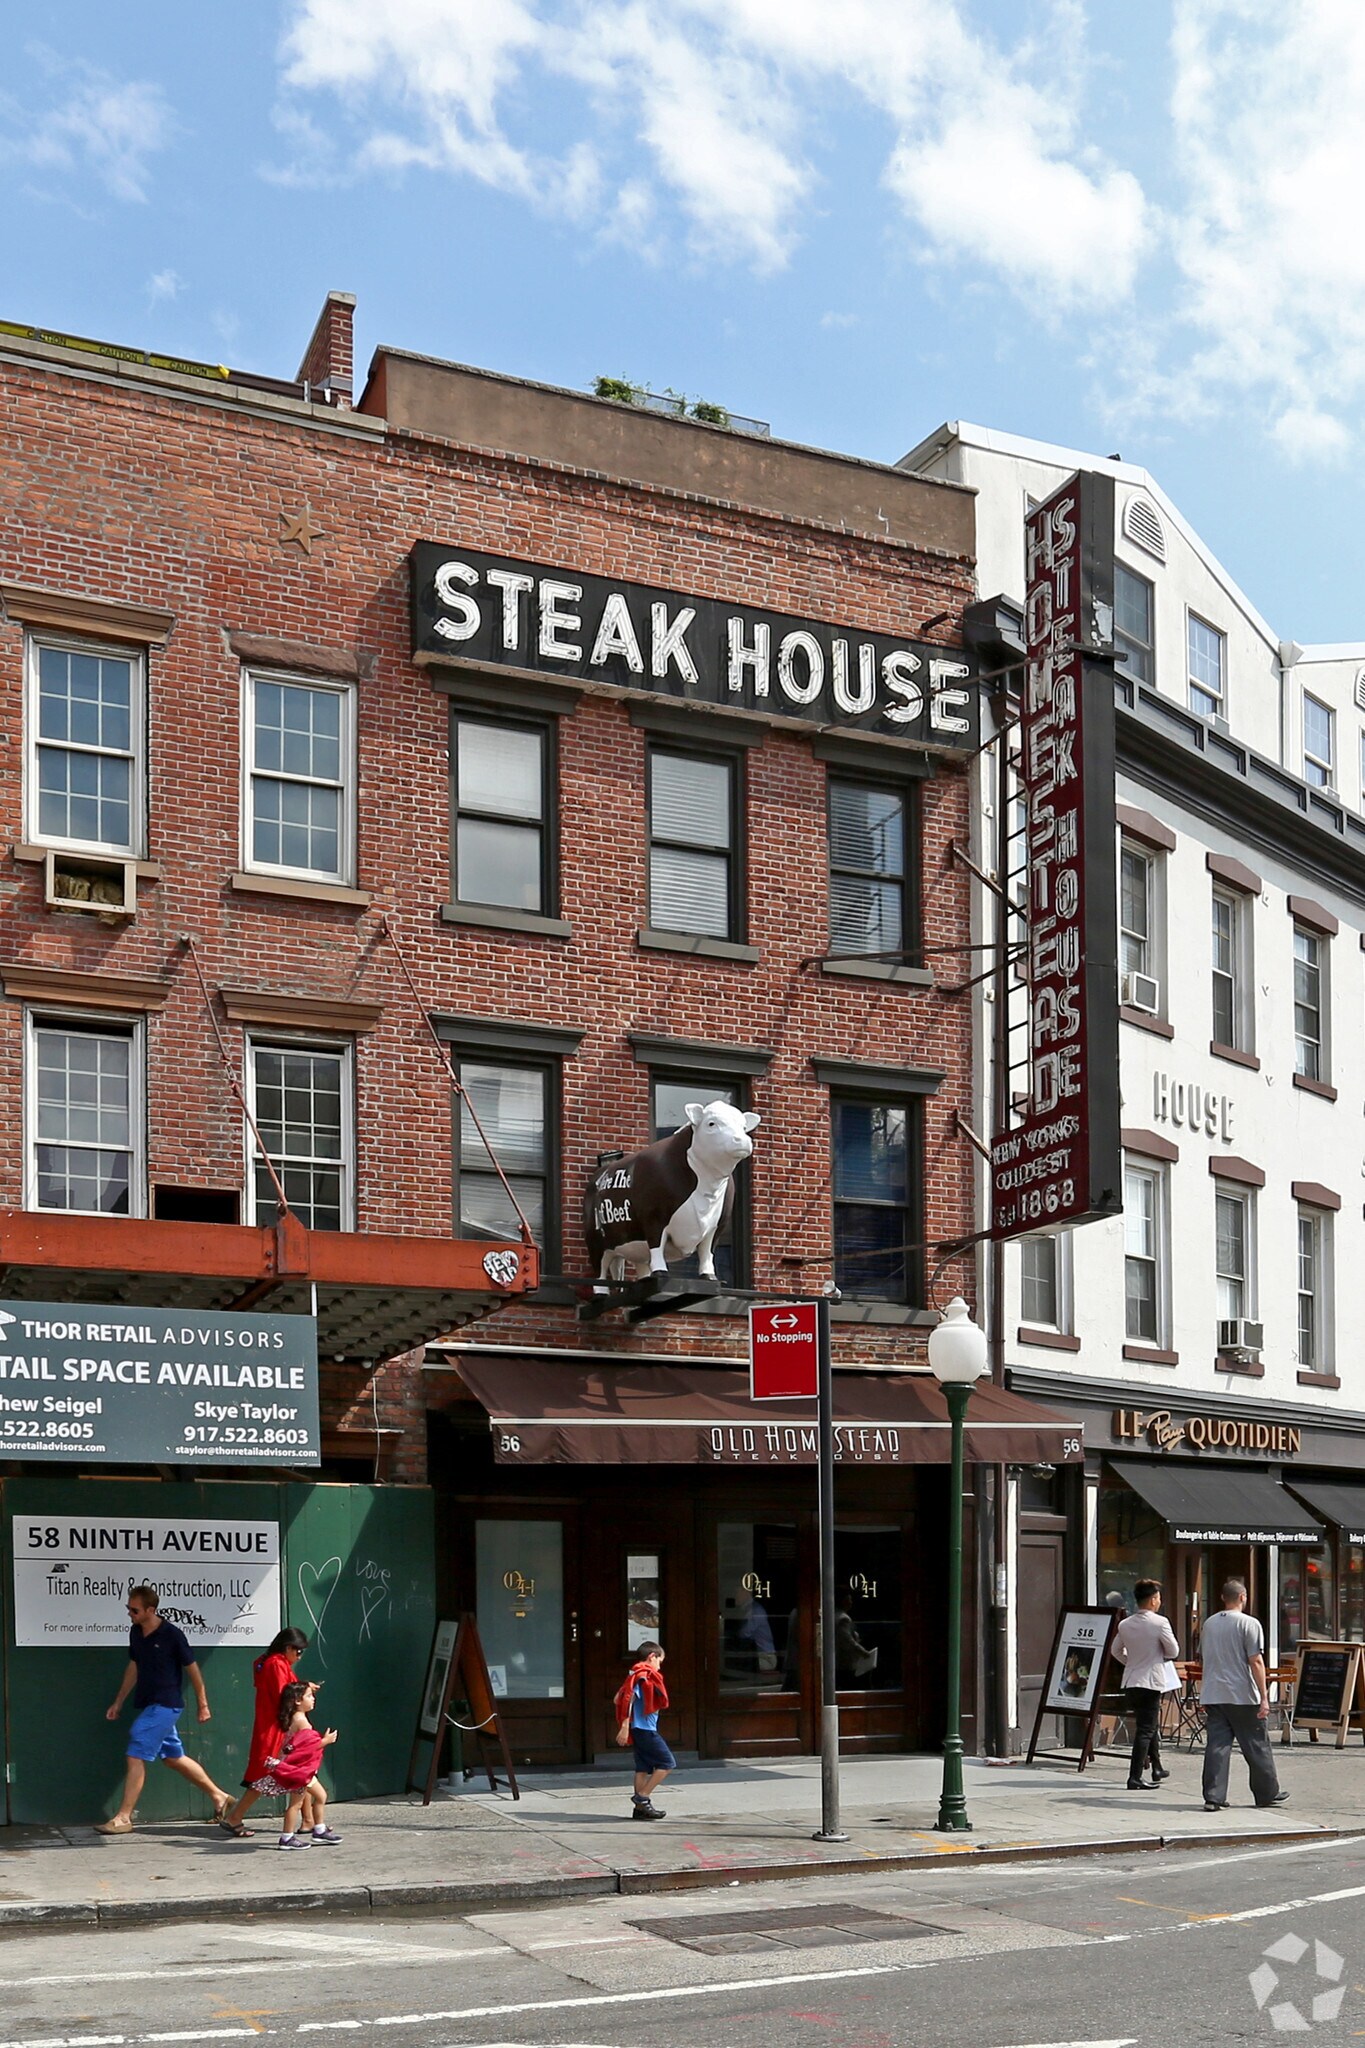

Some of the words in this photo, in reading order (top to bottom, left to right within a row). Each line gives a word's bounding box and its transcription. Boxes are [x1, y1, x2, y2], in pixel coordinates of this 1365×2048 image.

[26, 329, 67, 346] CUTION
[99, 346, 138, 361] CAUTION
[169, 360, 207, 375] CAUTION
[432, 559, 700, 684] STEAK
[726, 615, 971, 735] HOUSE
[1051, 497, 1079, 787] STEAK
[1024, 509, 1059, 1117] HOMESTEAD
[1053, 807, 1082, 1098] HOUSE
[1153, 1070, 1235, 1143] HOUSE
[612, 1169, 631, 1189] The
[604, 1198, 632, 1223] Beef
[1020, 1179, 1075, 1221] 1868
[21, 1320, 82, 1341] THOR
[86, 1324, 157, 1344] RETAIL
[162, 1328, 284, 1349] ADVISORS
[756, 1333, 770, 1343] No
[771, 1331, 813, 1344] Stopping
[0, 1355, 57, 1381] TAIL
[63, 1358, 151, 1384] SPACE
[157, 1362, 305, 1390] AVAILABLE
[43, 1396, 102, 1418] Seigel
[194, 1401, 239, 1422] Skye
[240, 1402, 298, 1424] Taylor
[184, 1425, 309, 1445] 917.522.8603
[711, 1428, 755, 1452] OLD
[765, 1425, 900, 1453] HOMSTEAD
[1116, 1409, 1144, 1438] LE
[1146, 1410, 1186, 1451] Pain
[1188, 1417, 1301, 1453] QUOTIDIEN
[175, 1445, 318, 1458] staylor@thorretailadvisors.com
[500, 1435, 521, 1452] 56
[1063, 1438, 1080, 1453] 56
[816, 1453, 900, 1461] OUSE
[28, 1526, 60, 1549] 58
[69, 1528, 153, 1551] NINTH
[162, 1530, 268, 1553] AVENUE
[46, 1576, 79, 1596] Titan
[84, 1576, 124, 1600] Realty
[230, 1579, 251, 1598] LLC
[43, 1623, 58, 1633] For
[60, 1624, 83, 1633] more
[85, 1623, 130, 1633] informatio
[1077, 1628, 1095, 1638] $18
[490, 1670, 503, 1688] A
